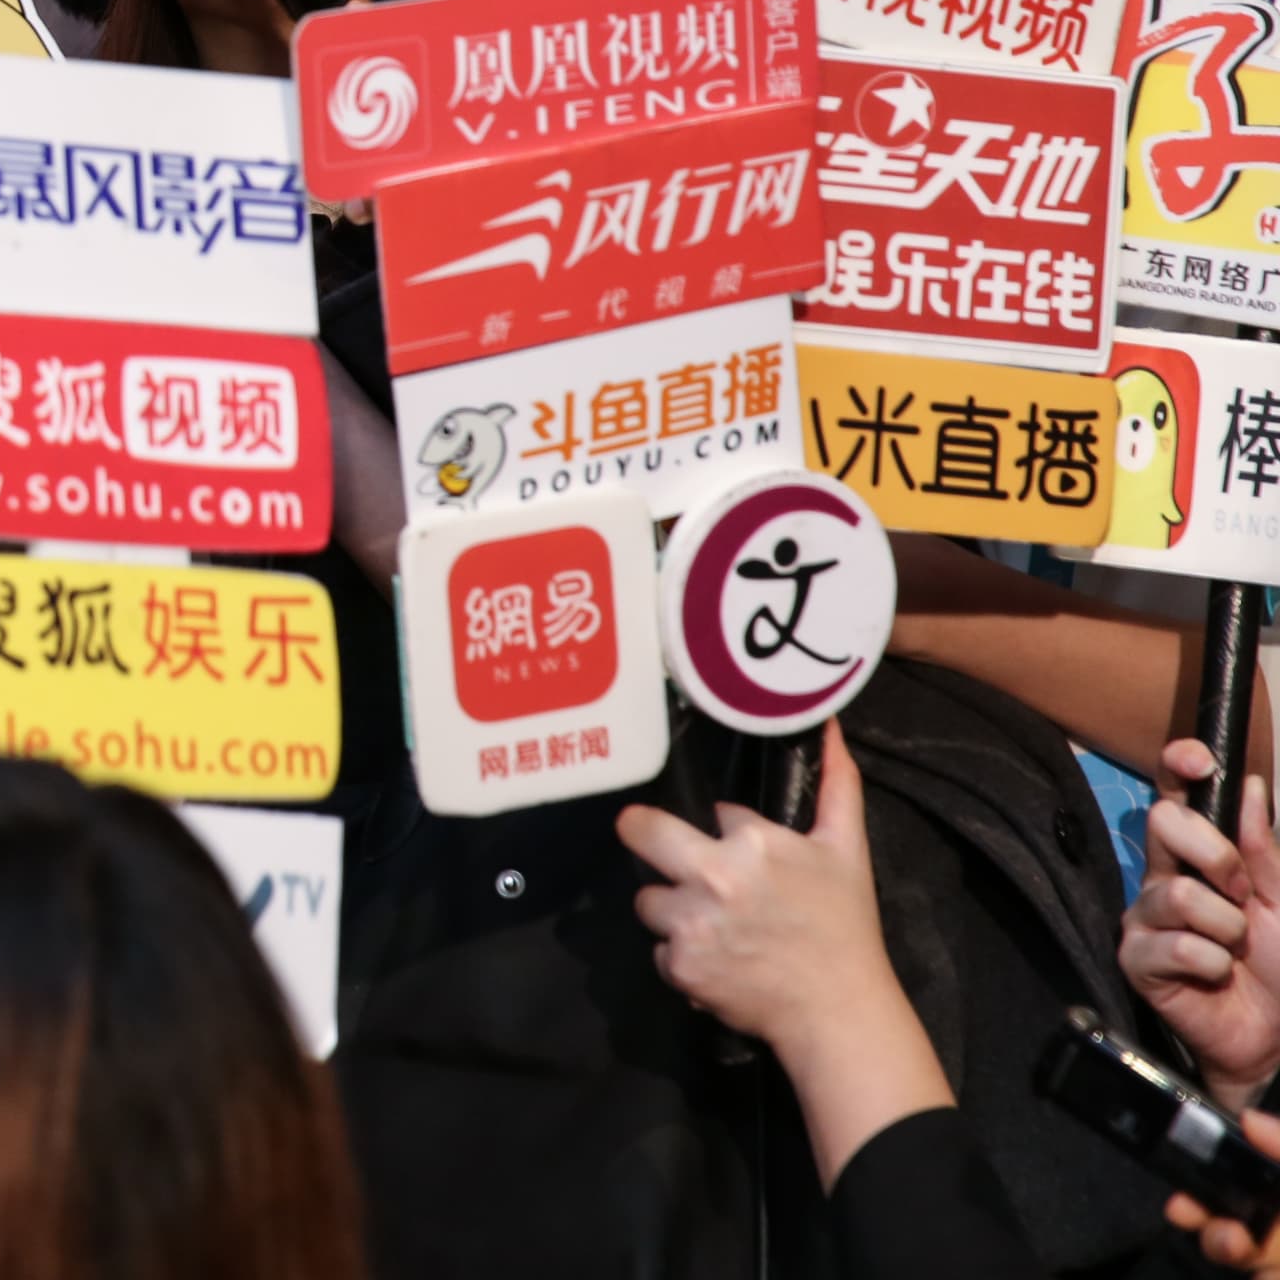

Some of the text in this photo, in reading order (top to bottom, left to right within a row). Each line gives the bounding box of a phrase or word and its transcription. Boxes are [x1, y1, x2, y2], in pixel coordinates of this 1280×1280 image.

[448, 0, 739, 109] 鳳凰視頻
[453, 79, 737, 146] V.IFENG
[564, 150, 811, 270] 风行网
[479, 263, 745, 348] 新一代视频
[1199, 290, 1244, 307] RADIO
[1247, 298, 1277, 313] AND
[520, 342, 783, 463] 斗鱼直播
[519, 420, 781, 502] DOUYU.COM
[810, 385, 1100, 508] 米直播
[464, 567, 602, 663] 網易
[493, 655, 581, 685] NEWS
[478, 726, 611, 783] 网易新闻
